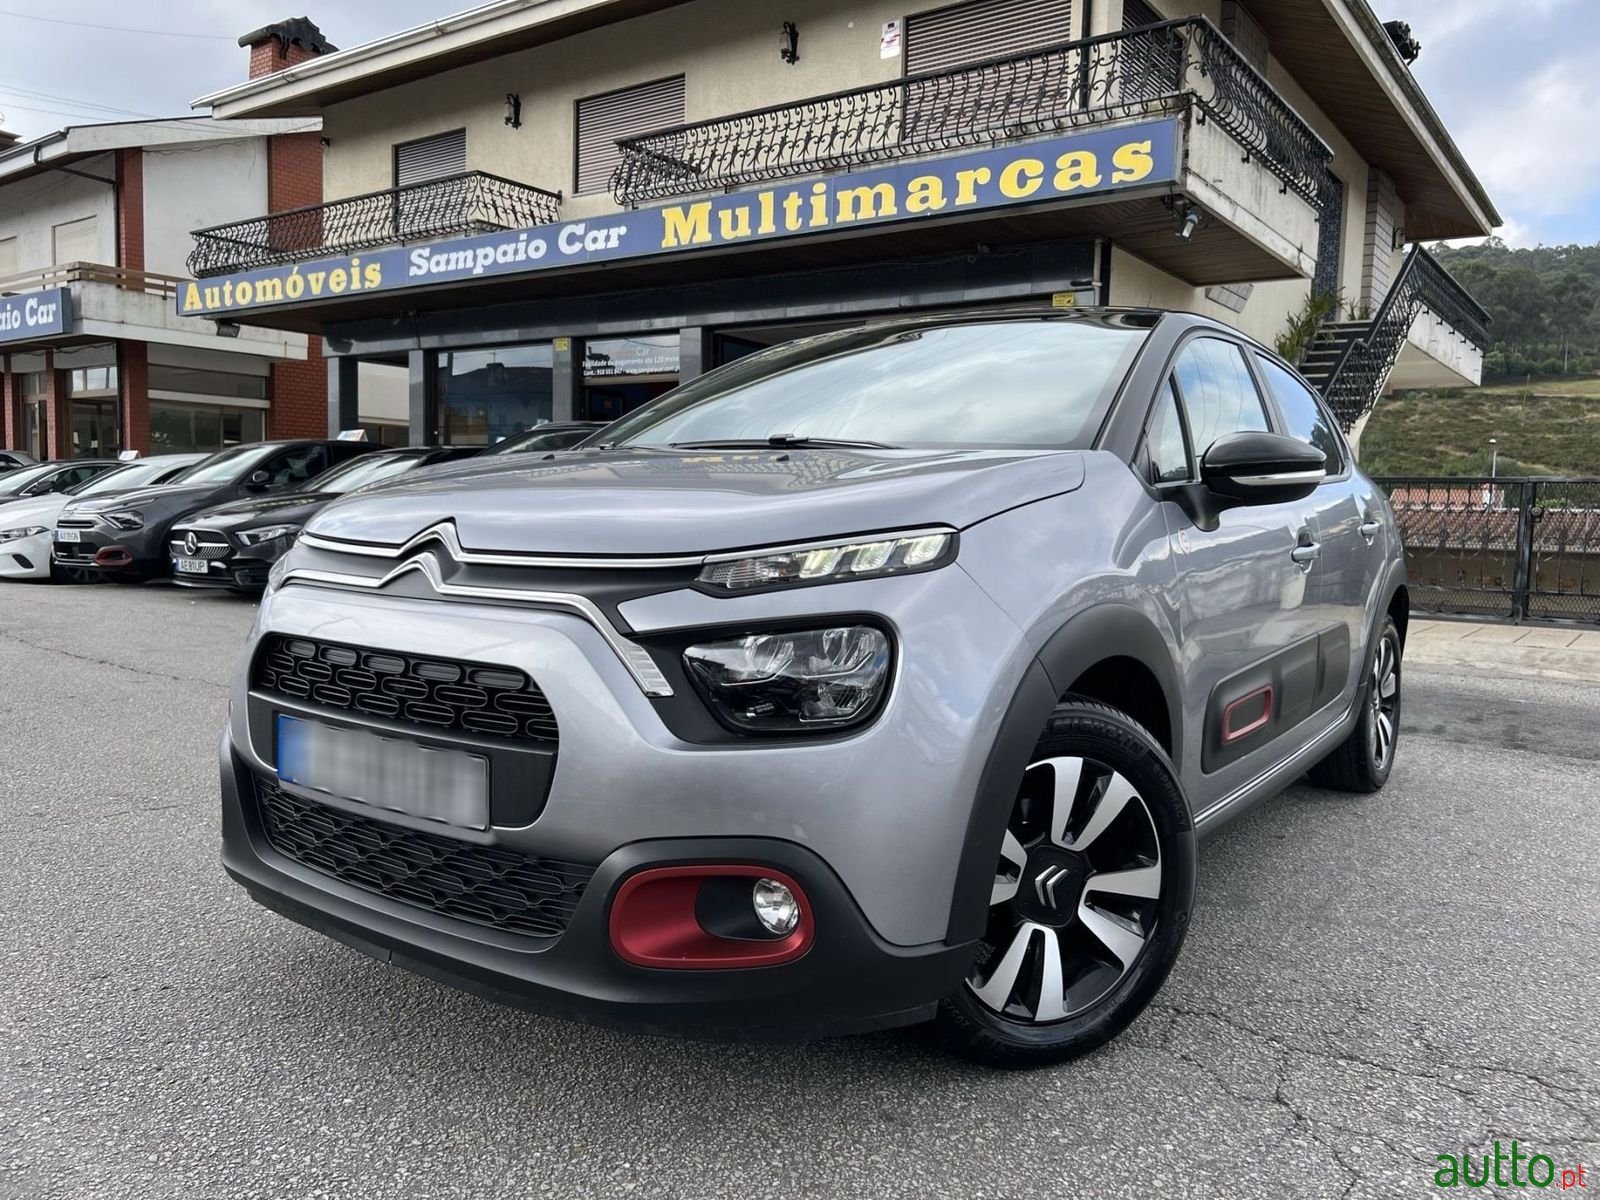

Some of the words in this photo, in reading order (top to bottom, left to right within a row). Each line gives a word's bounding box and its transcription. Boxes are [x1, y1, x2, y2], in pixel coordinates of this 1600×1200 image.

[183, 259, 382, 311] Automóveis
[409, 233, 548, 276] Sampaio
[558, 223, 627, 255] Car
[661, 139, 1154, 248] Multimarcas
[25, 297, 56, 327] Car
